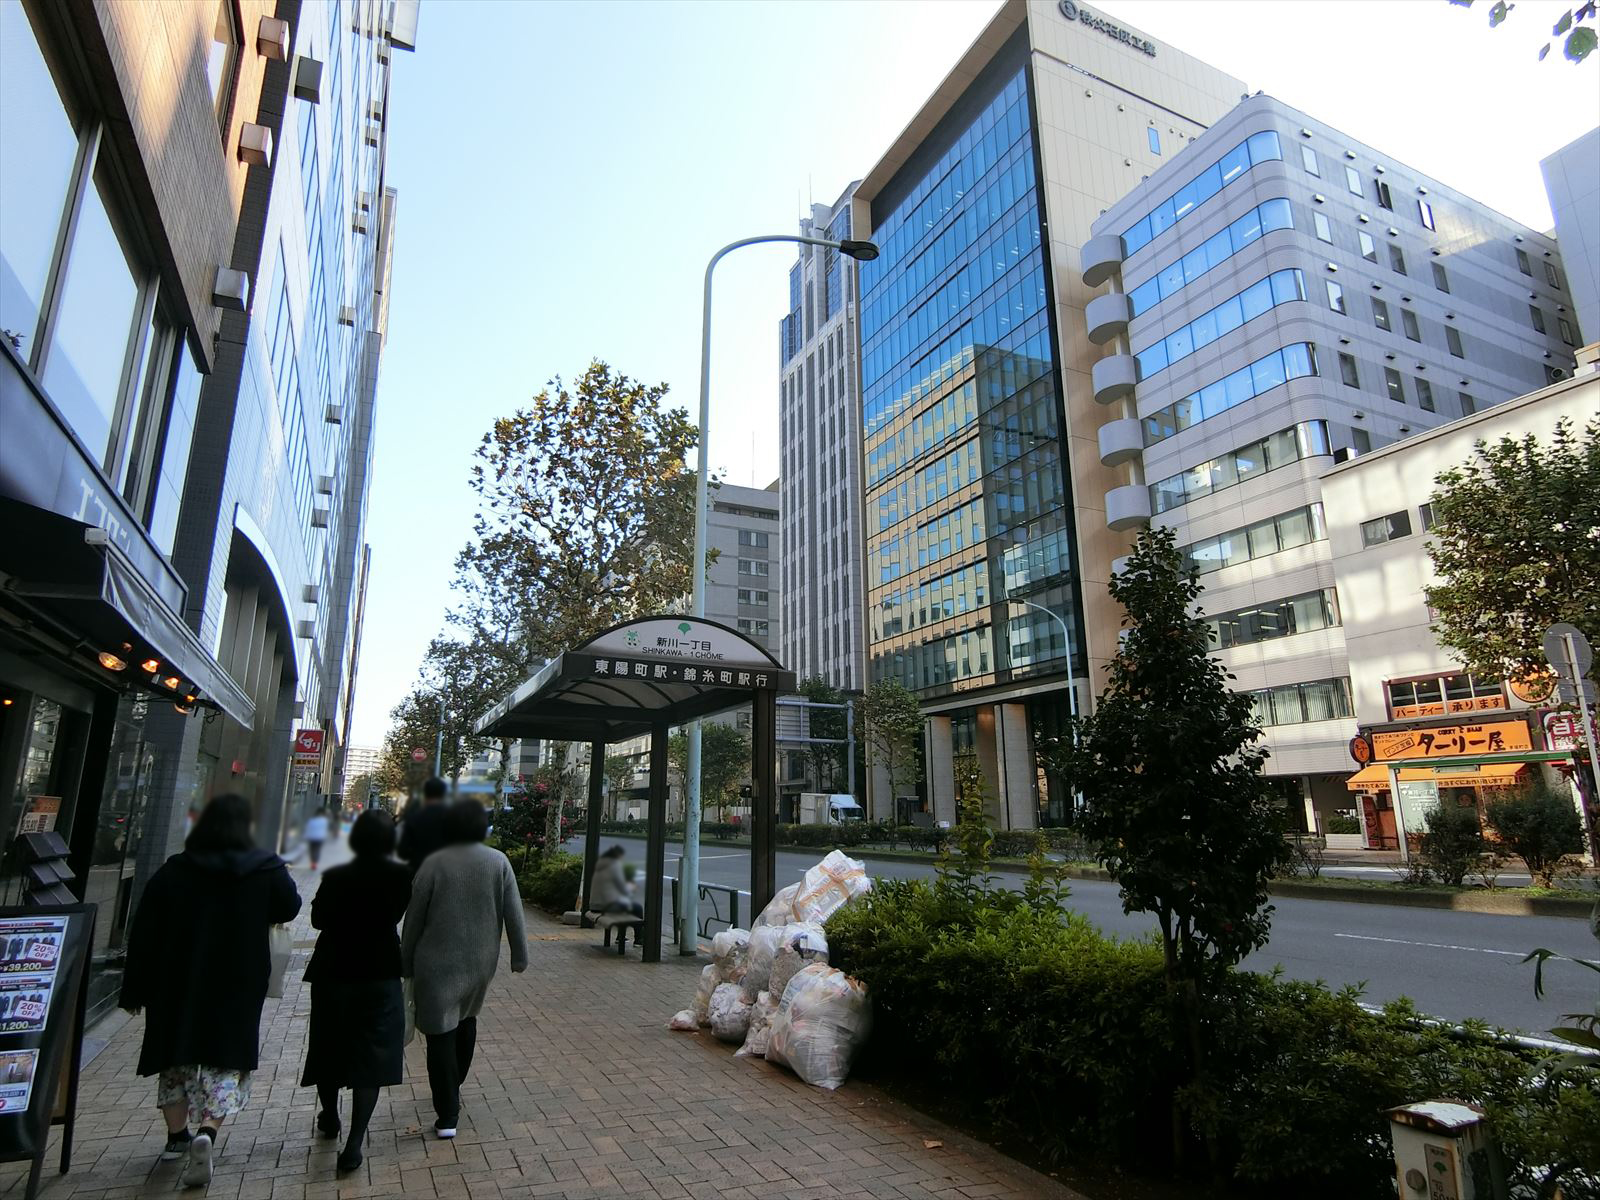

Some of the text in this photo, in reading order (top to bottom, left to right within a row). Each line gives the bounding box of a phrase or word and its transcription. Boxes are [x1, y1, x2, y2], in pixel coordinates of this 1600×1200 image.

[656, 637, 711, 651] 新川一丁目
[595, 659, 769, 687] 東陽町駅・錦糸町駅行
[298, 732, 321, 752] くすり
[1417, 730, 1506, 756] ターリー屋
